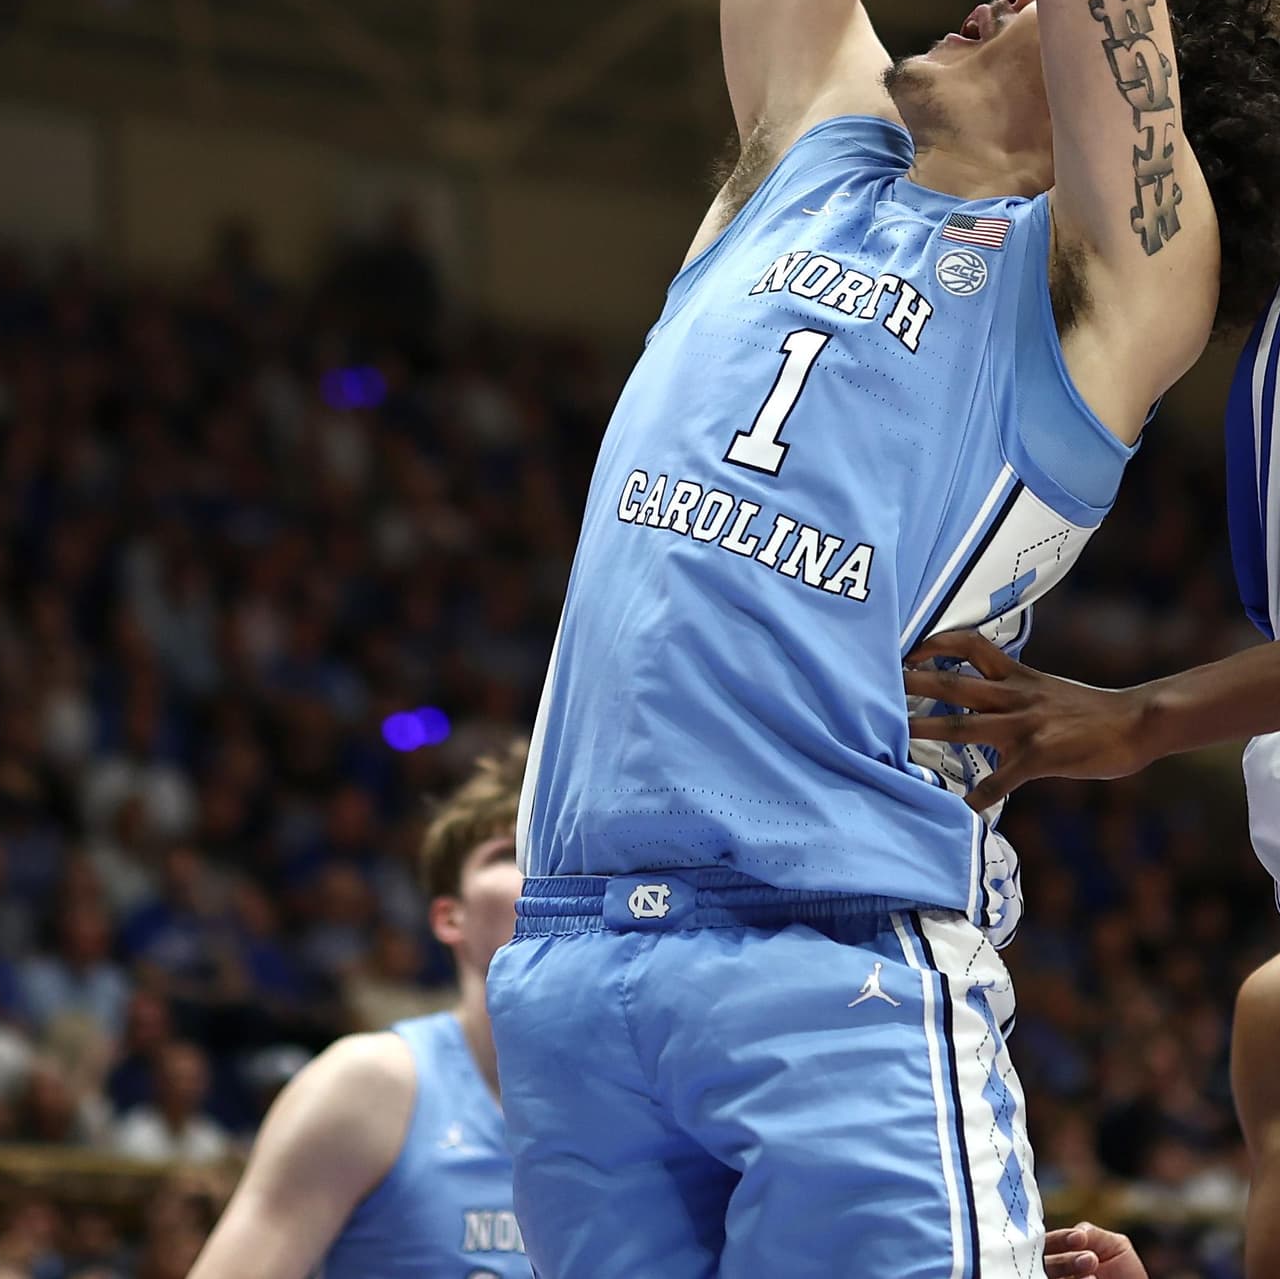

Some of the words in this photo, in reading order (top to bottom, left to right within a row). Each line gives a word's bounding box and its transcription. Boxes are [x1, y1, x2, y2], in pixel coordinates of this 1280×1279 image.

[748, 251, 934, 354] NORTH
[722, 327, 834, 477] 1
[617, 469, 875, 602] CAROLINA
[462, 1208, 526, 1254] NO
